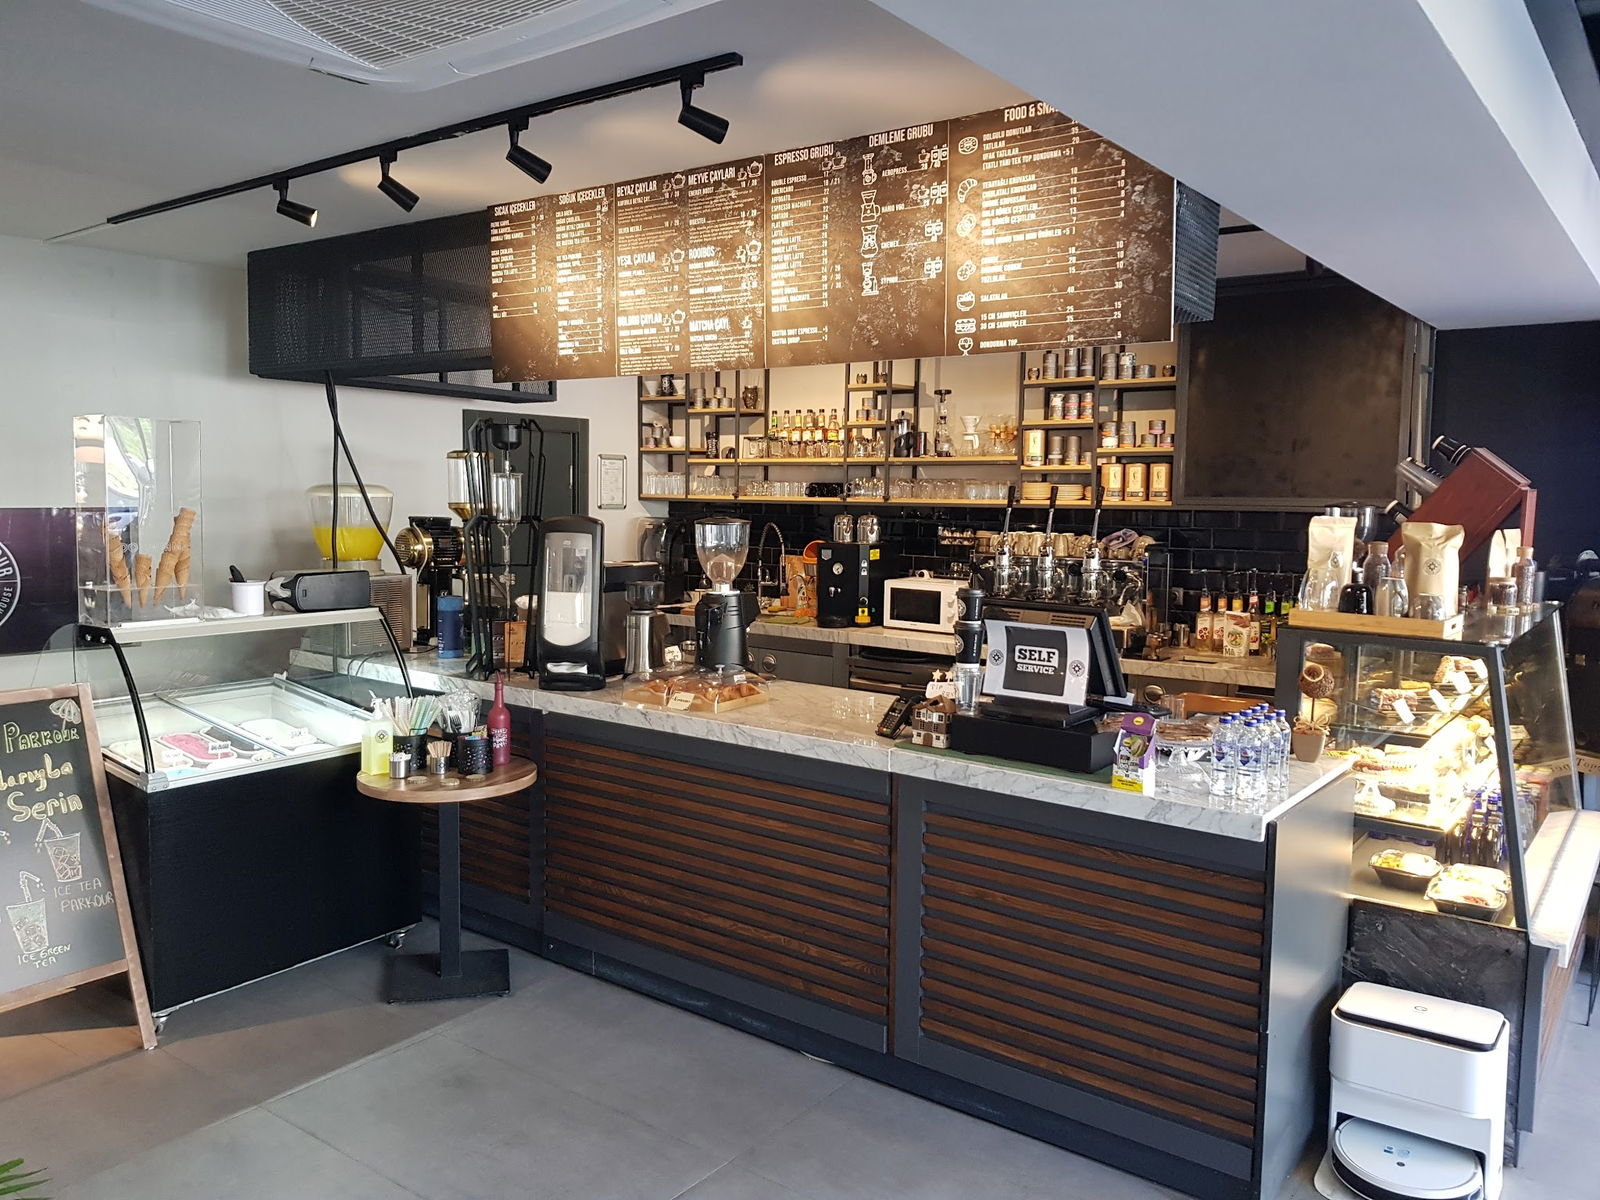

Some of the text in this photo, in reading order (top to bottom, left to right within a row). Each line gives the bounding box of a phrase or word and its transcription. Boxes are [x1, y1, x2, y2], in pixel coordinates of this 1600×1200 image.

[1005, 106, 1027, 122] FOOD
[1028, 103, 1035, 118] &
[869, 123, 934, 147] DEMLEME GRUBU
[774, 143, 834, 166] ESPRESSO GRUBU
[688, 167, 735, 186] MEYVE ÇAYLARI
[787, 174, 808, 184] ESPRESSO
[881, 166, 908, 178] AEROPRESS
[617, 181, 657, 198] BEYAZ ÇAYLAR
[771, 186, 794, 195] AMERICANO
[559, 190, 577, 205] SOĞUK
[495, 206, 509, 217] SICAK
[688, 245, 715, 260] ROOIBOS
[1017, 648, 1056, 663] SELF
[1016, 663, 1055, 675] SERVICE
[3, 722, 80, 753] PARKOUR
[7, 791, 83, 822] Serin
[54, 877, 102, 898] ICE TEA
[61, 891, 115, 912] PARKOUR
[17, 953, 37, 965] ICE
[33, 956, 57, 969] TEA
